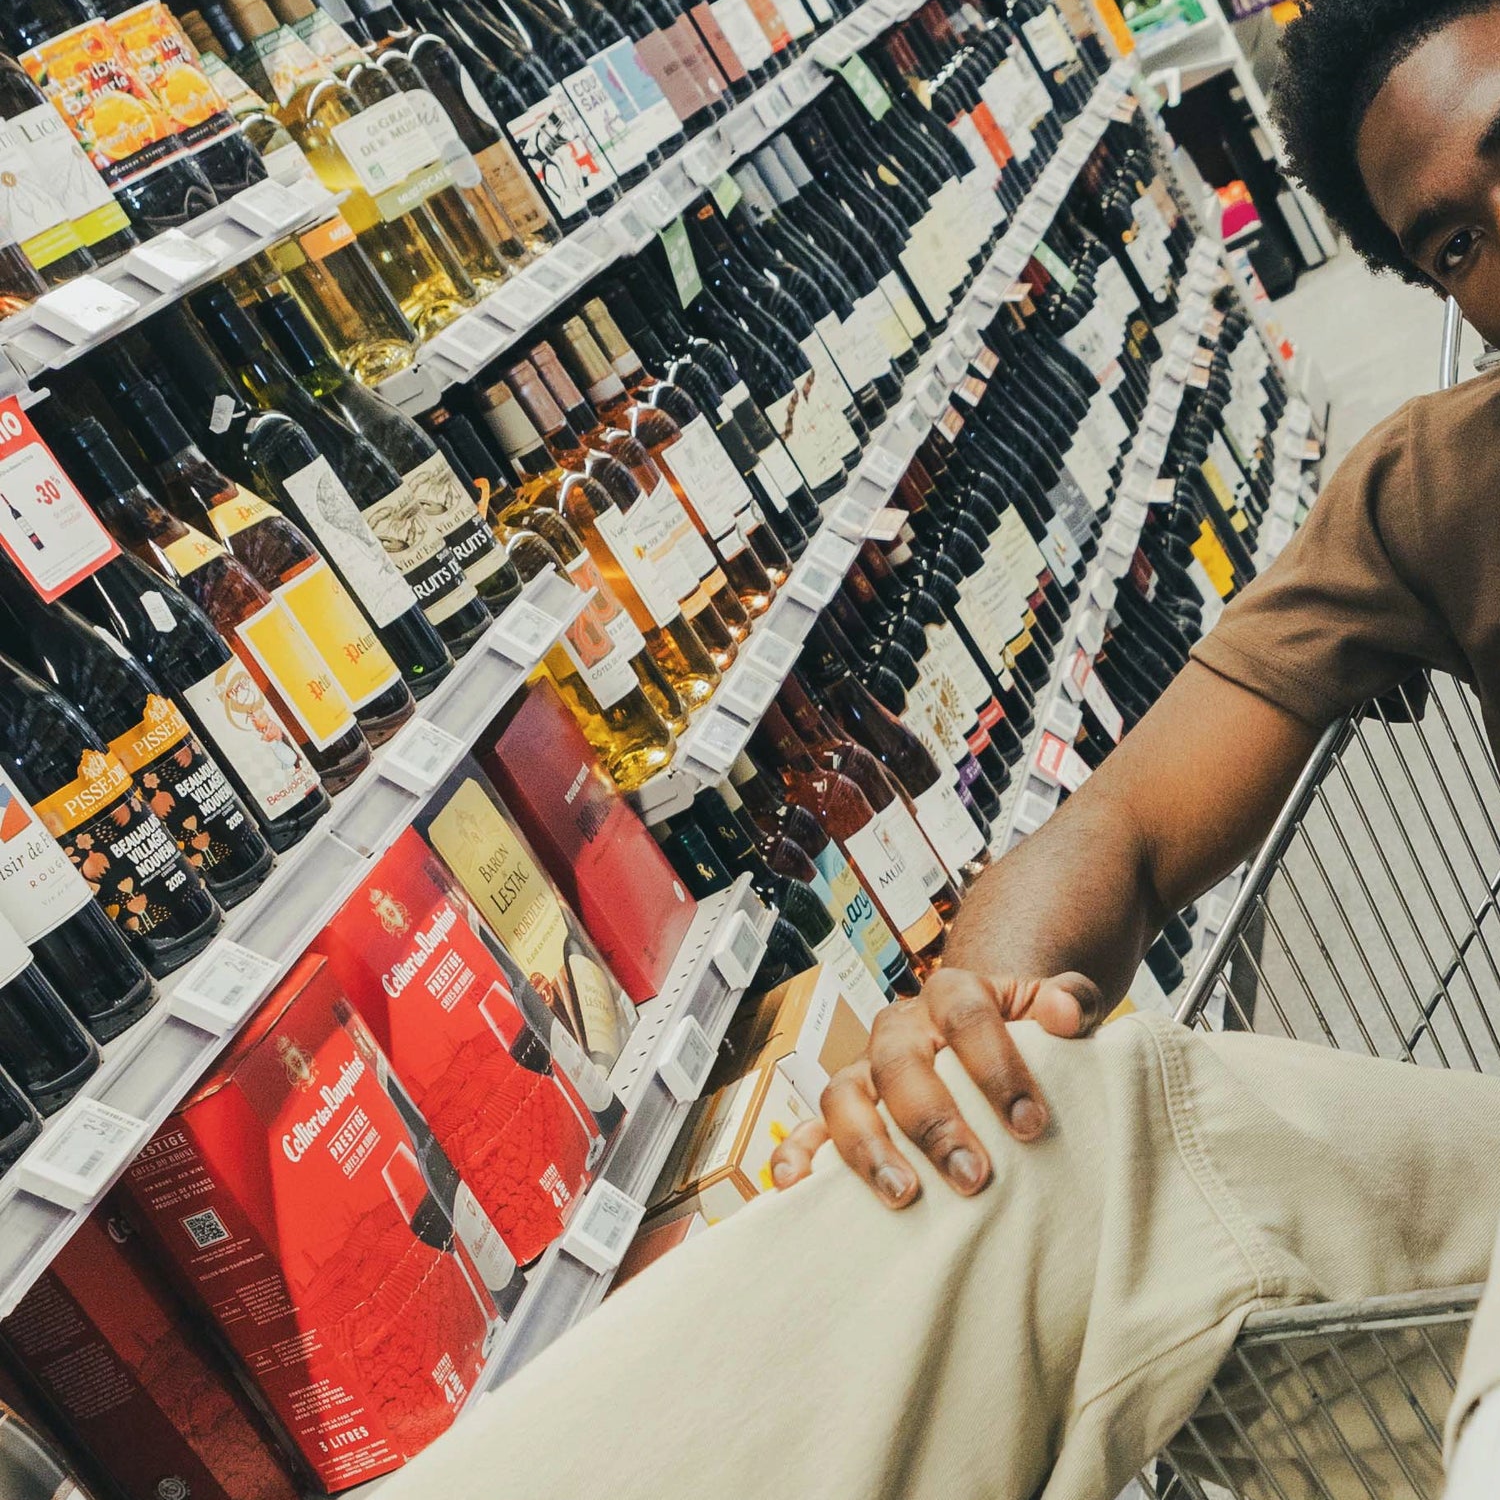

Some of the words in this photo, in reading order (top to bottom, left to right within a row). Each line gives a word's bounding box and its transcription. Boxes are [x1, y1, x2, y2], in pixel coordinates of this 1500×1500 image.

[477, 842, 511, 885] BARON
[490, 860, 531, 916] LESTAC
[426, 950, 464, 998] PRESTIGE
[328, 1108, 370, 1161] PRESTIGE
[331, 1425, 370, 1451] LITRES
